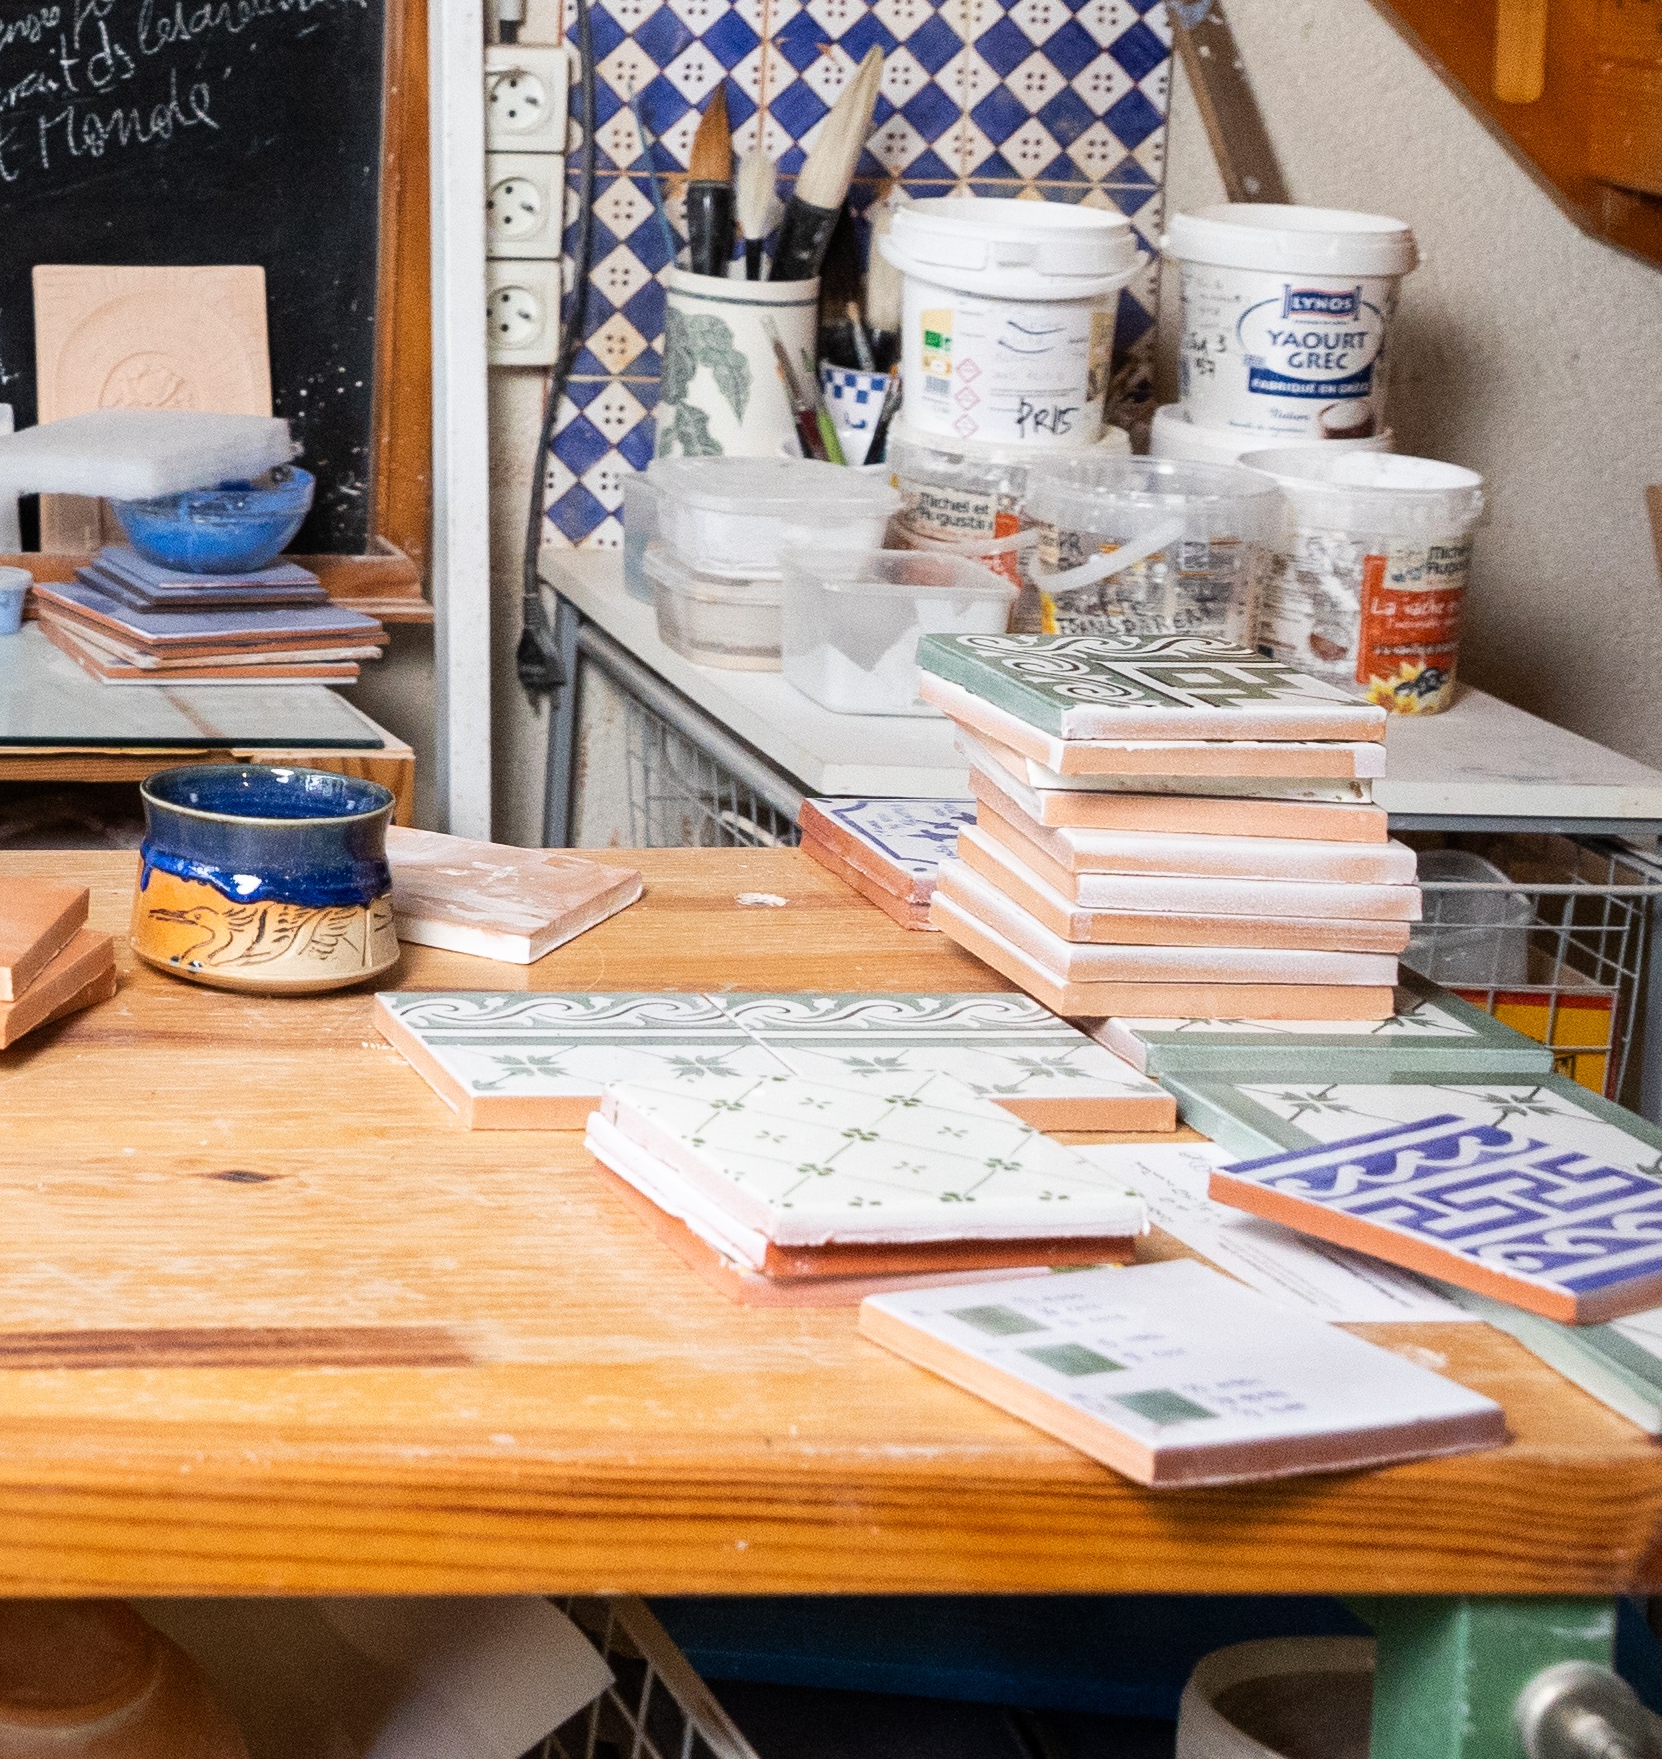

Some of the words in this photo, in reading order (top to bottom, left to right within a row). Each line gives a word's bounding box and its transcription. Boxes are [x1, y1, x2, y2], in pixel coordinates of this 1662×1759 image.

[35, 67, 222, 171] Monde
[1267, 328, 1369, 351] YAOURT
[1287, 351, 1349, 370] GREC
[918, 491, 970, 514] Michel
[973, 503, 990, 516] et
[1370, 597, 1397, 616] La
